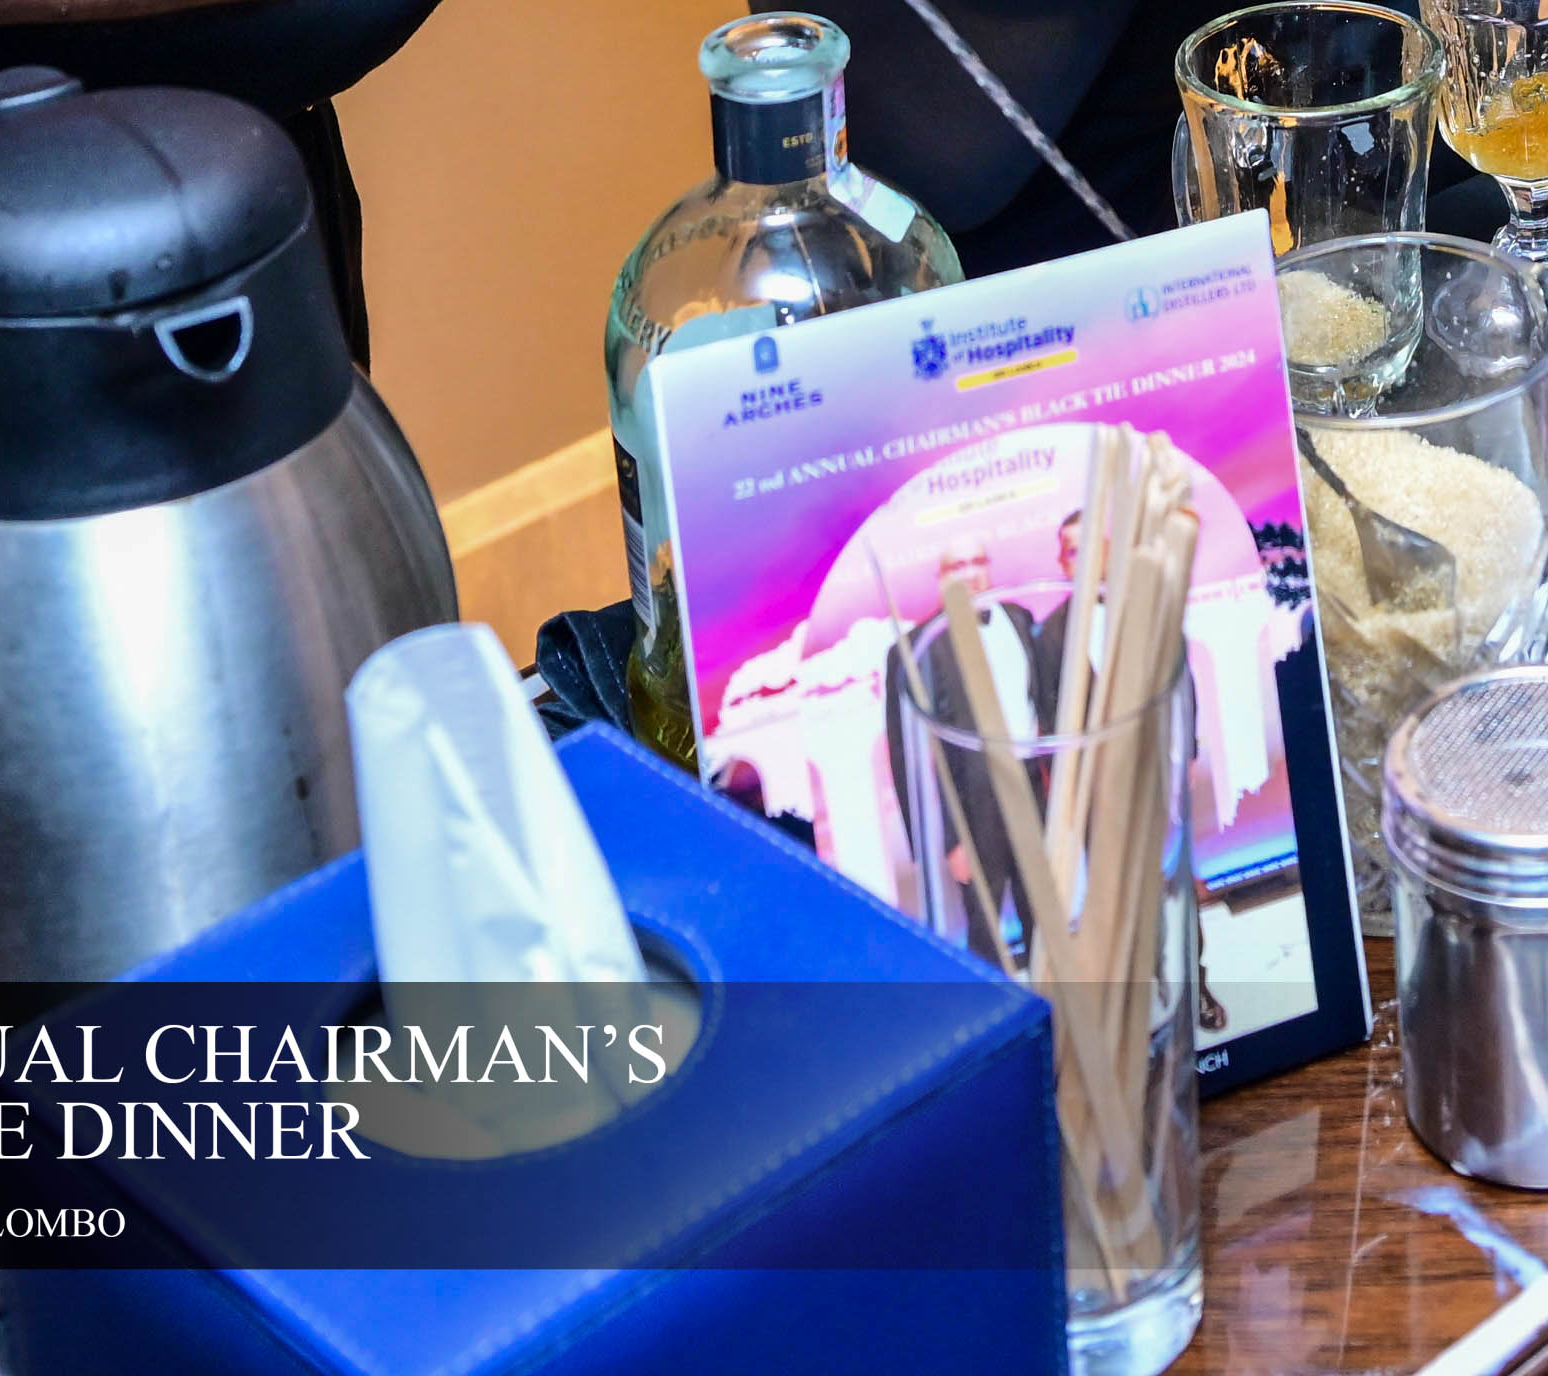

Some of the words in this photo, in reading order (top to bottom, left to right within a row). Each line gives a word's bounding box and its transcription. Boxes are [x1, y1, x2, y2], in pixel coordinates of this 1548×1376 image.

[967, 324, 1076, 365] Hospitality
[723, 391, 824, 428] ARCHES
[740, 379, 801, 404] NINE
[1020, 390, 1089, 423] BLACK
[1092, 379, 1127, 405] TIE
[1131, 358, 1215, 395] DINNER
